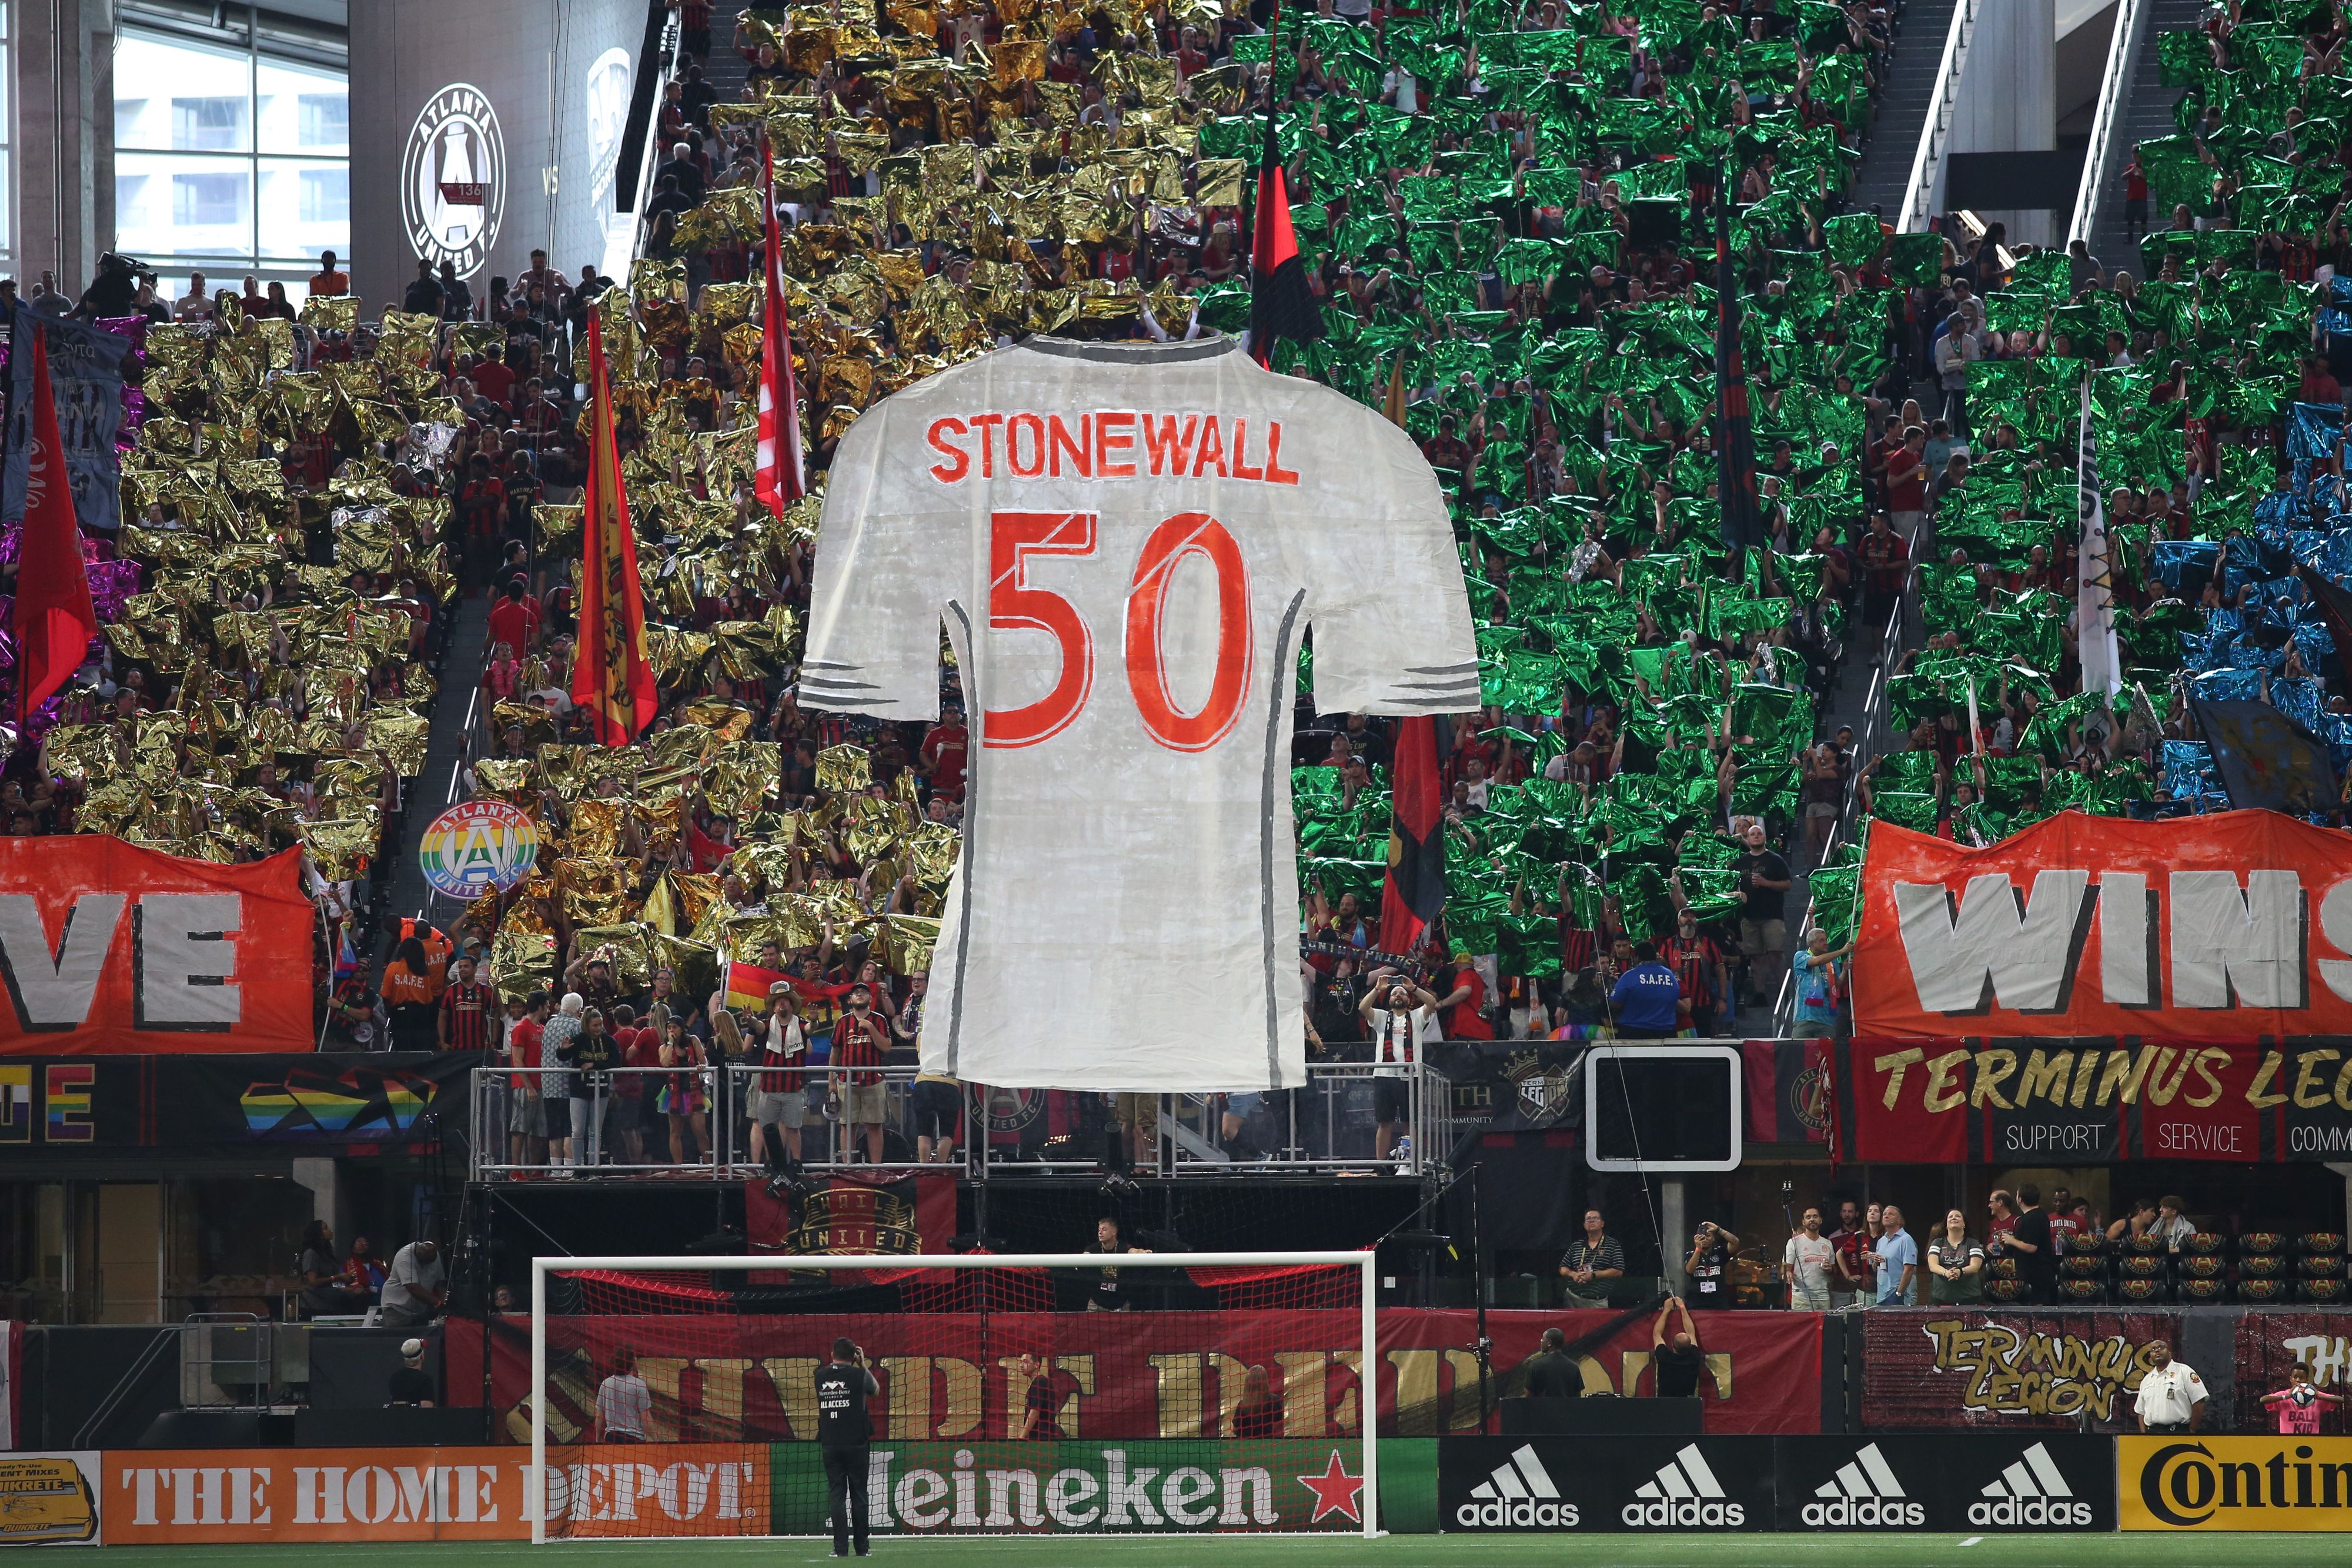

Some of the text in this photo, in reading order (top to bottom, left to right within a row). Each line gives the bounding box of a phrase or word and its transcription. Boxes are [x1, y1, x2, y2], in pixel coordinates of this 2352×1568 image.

[419, 91, 492, 143] ATLANTA
[459, 184, 482, 196] 136
[926, 410, 1300, 486] STONEWALL
[983, 510, 1254, 754] 50
[442, 804, 520, 831] ATLANTA
[434, 872, 484, 896] UNITE
[395, 974, 425, 989] S.A.F.E.
[1639, 974, 1673, 987] S.A.F.E.
[1875, 1045, 2233, 1114] TERMINUS
[1521, 1085, 1566, 1108] LEGION
[1446, 1116, 1494, 1124] MMUNITY
[2006, 1124, 2106, 1150] SUPPORT
[2159, 1124, 2242, 1152] SERVICE
[799, 1229, 906, 1249] UNITED
[1923, 1319, 2154, 1392] TERMINUS
[828, 1399, 850, 1408] ACCESS
[1964, 1367, 2117, 1423] LEGION
[2288, 1411, 2316, 1422] BALL
[2294, 1423, 2313, 1434] KID
[122, 1462, 754, 1526] THE HOME DEPOT
[1456, 1497, 1580, 1527] adidas
[1622, 1496, 1745, 1526] adidas
[1801, 1496, 1925, 1526] adidas
[1967, 1495, 2093, 1525] adidas
[3, 1523, 51, 1532] QUIKRETE
